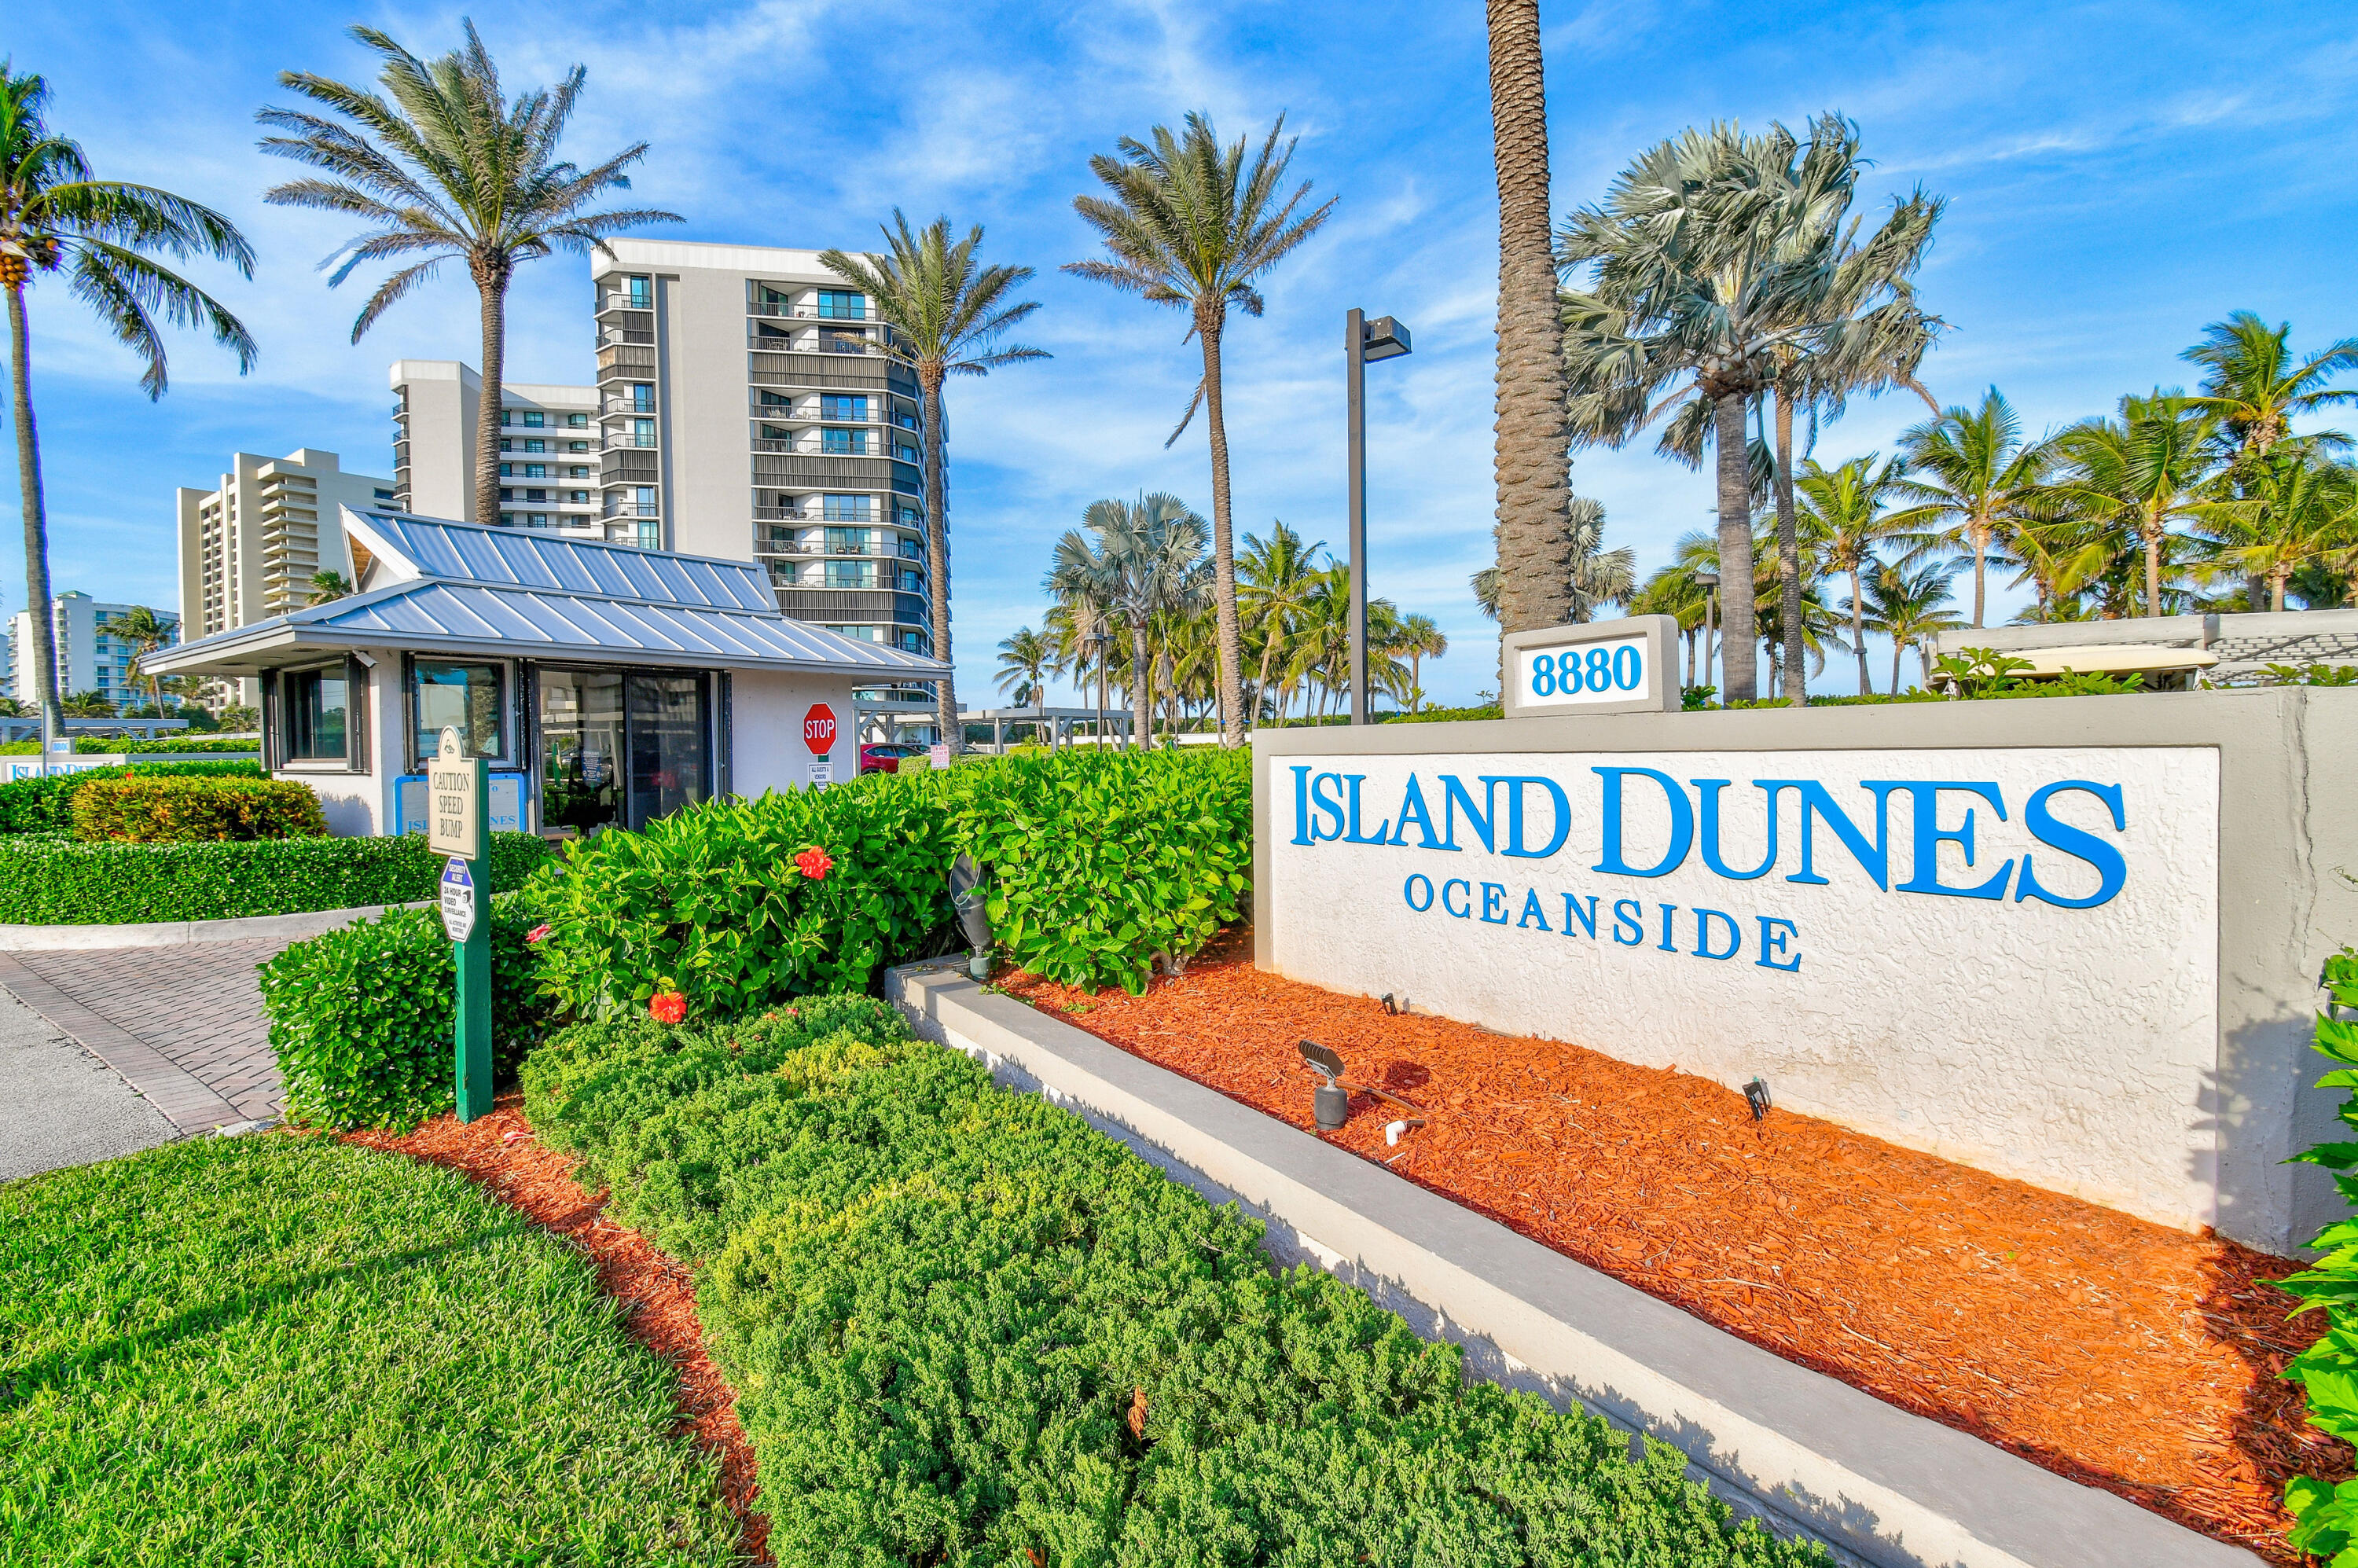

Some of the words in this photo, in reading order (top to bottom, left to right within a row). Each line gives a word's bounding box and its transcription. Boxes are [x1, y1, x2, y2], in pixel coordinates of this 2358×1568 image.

[1532, 645, 1642, 697] 8880
[806, 719, 835, 739] STOP
[433, 772, 469, 791] CAUTION
[439, 795, 464, 815] SPEED
[440, 818, 463, 839] BUMP
[490, 815, 516, 826] NES
[1289, 766, 1571, 858] ISLAND
[1590, 766, 2127, 909] DUNES
[449, 864, 465, 874] SECURITY
[451, 872, 464, 883] ALERT
[444, 886, 449, 894] 24
[450, 887, 461, 897] HOUR
[444, 896, 456, 906] VIDEO
[444, 906, 466, 918] SURVEILLANCE
[1404, 873, 1802, 972] OCEANSIDE
